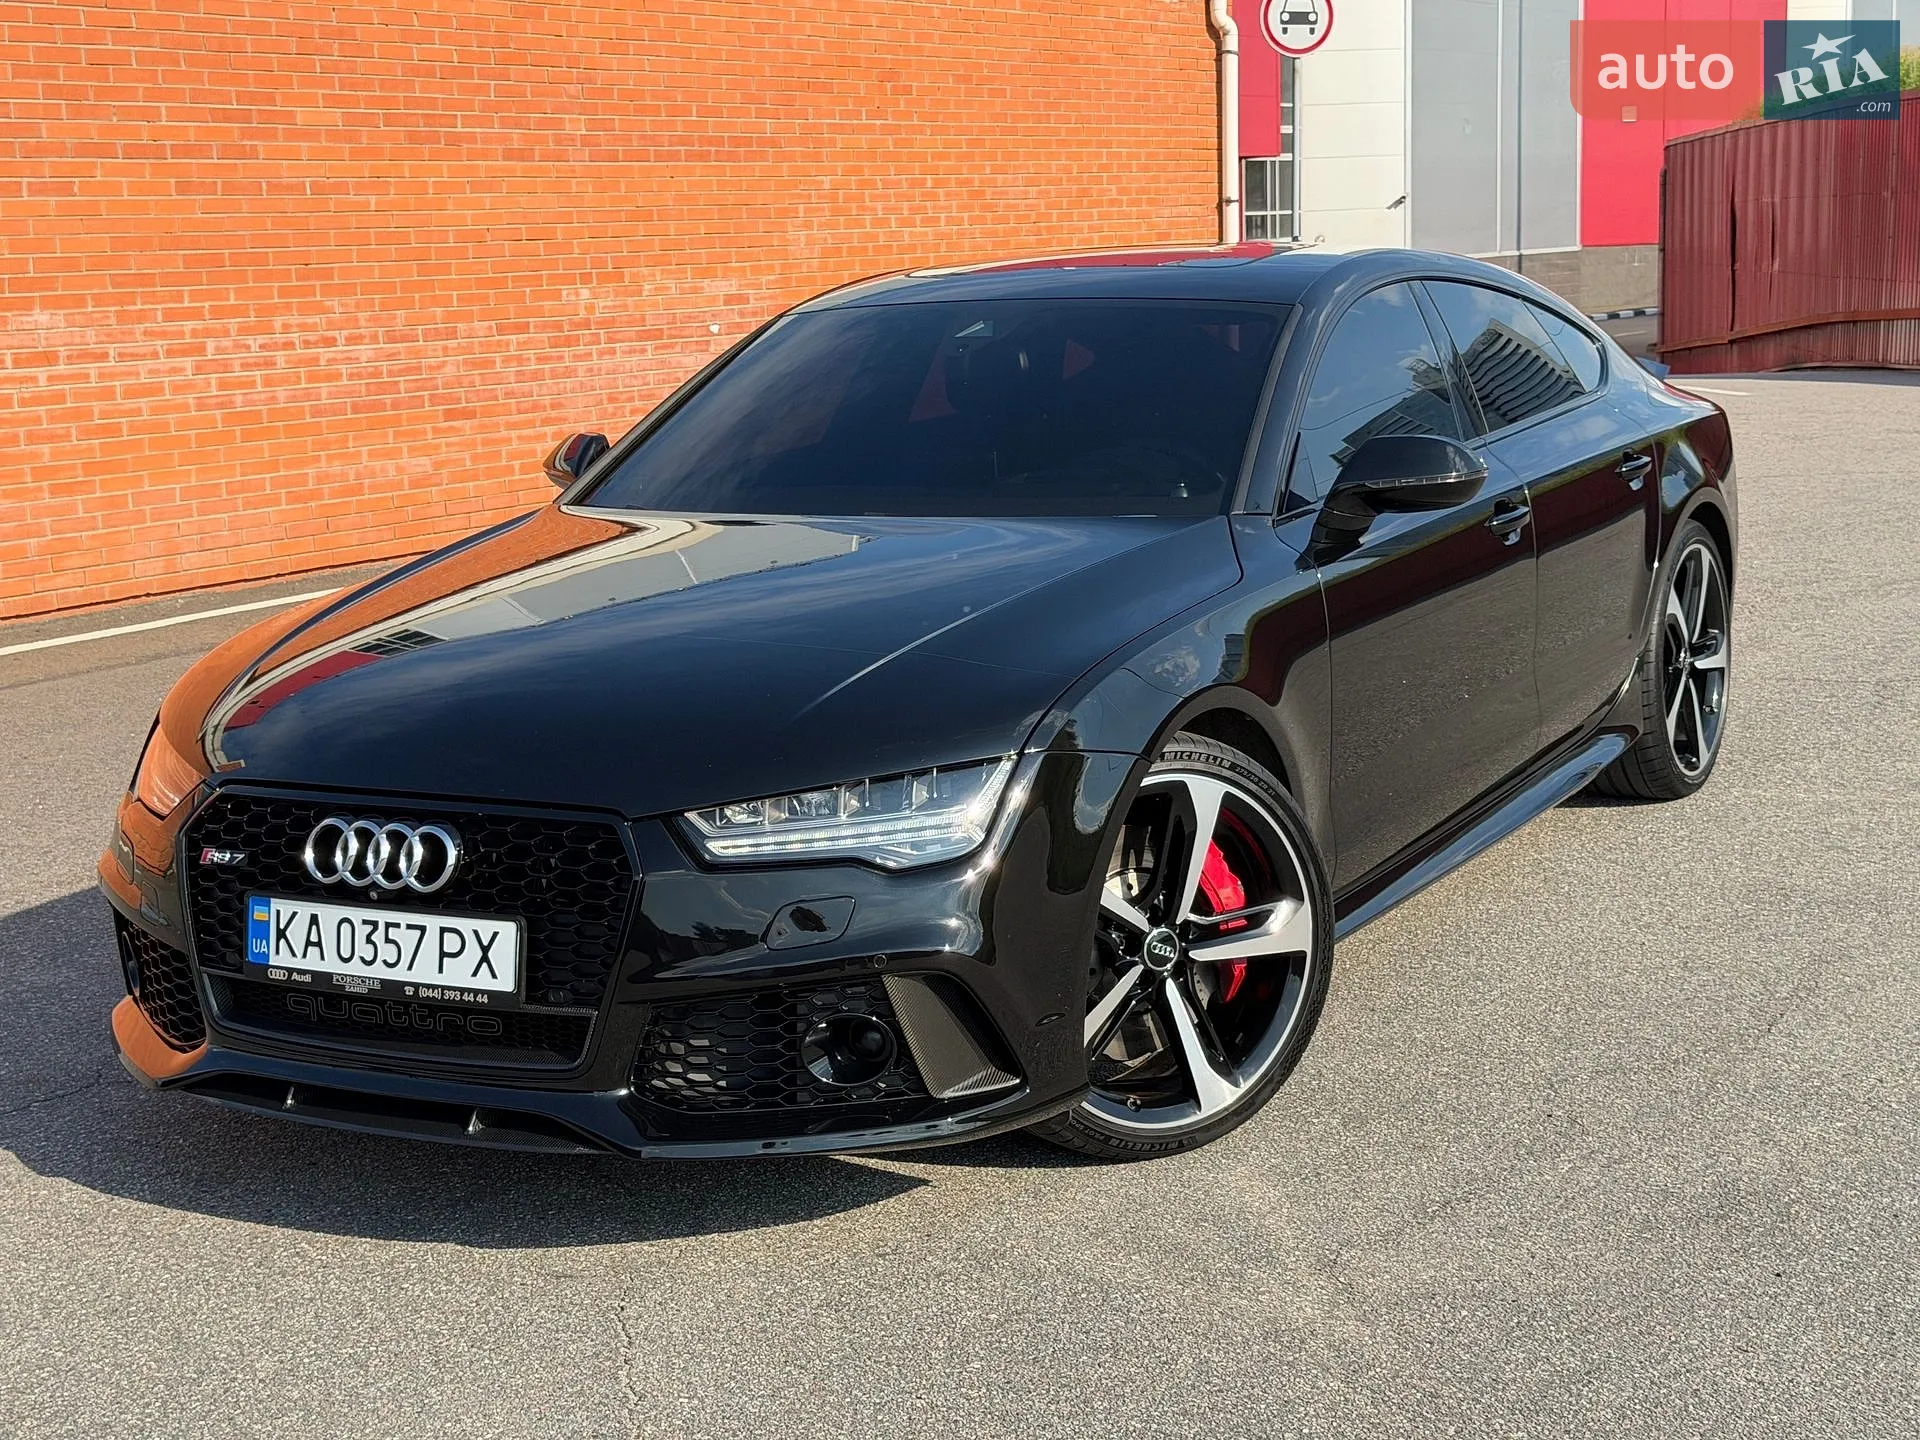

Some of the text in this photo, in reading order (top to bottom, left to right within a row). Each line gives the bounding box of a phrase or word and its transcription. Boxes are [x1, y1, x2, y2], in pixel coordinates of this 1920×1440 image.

[1164, 751, 1232, 769] MICHELIN
[252, 938, 268, 955] UA
[275, 908, 500, 980] KA 0357 PX
[291, 972, 312, 983] Audi
[332, 974, 381, 988] PORSCHE
[418, 986, 489, 1004] (044) 393 44 44
[286, 992, 503, 1036] quattro
[1109, 1138, 1179, 1151] MICHELIN
